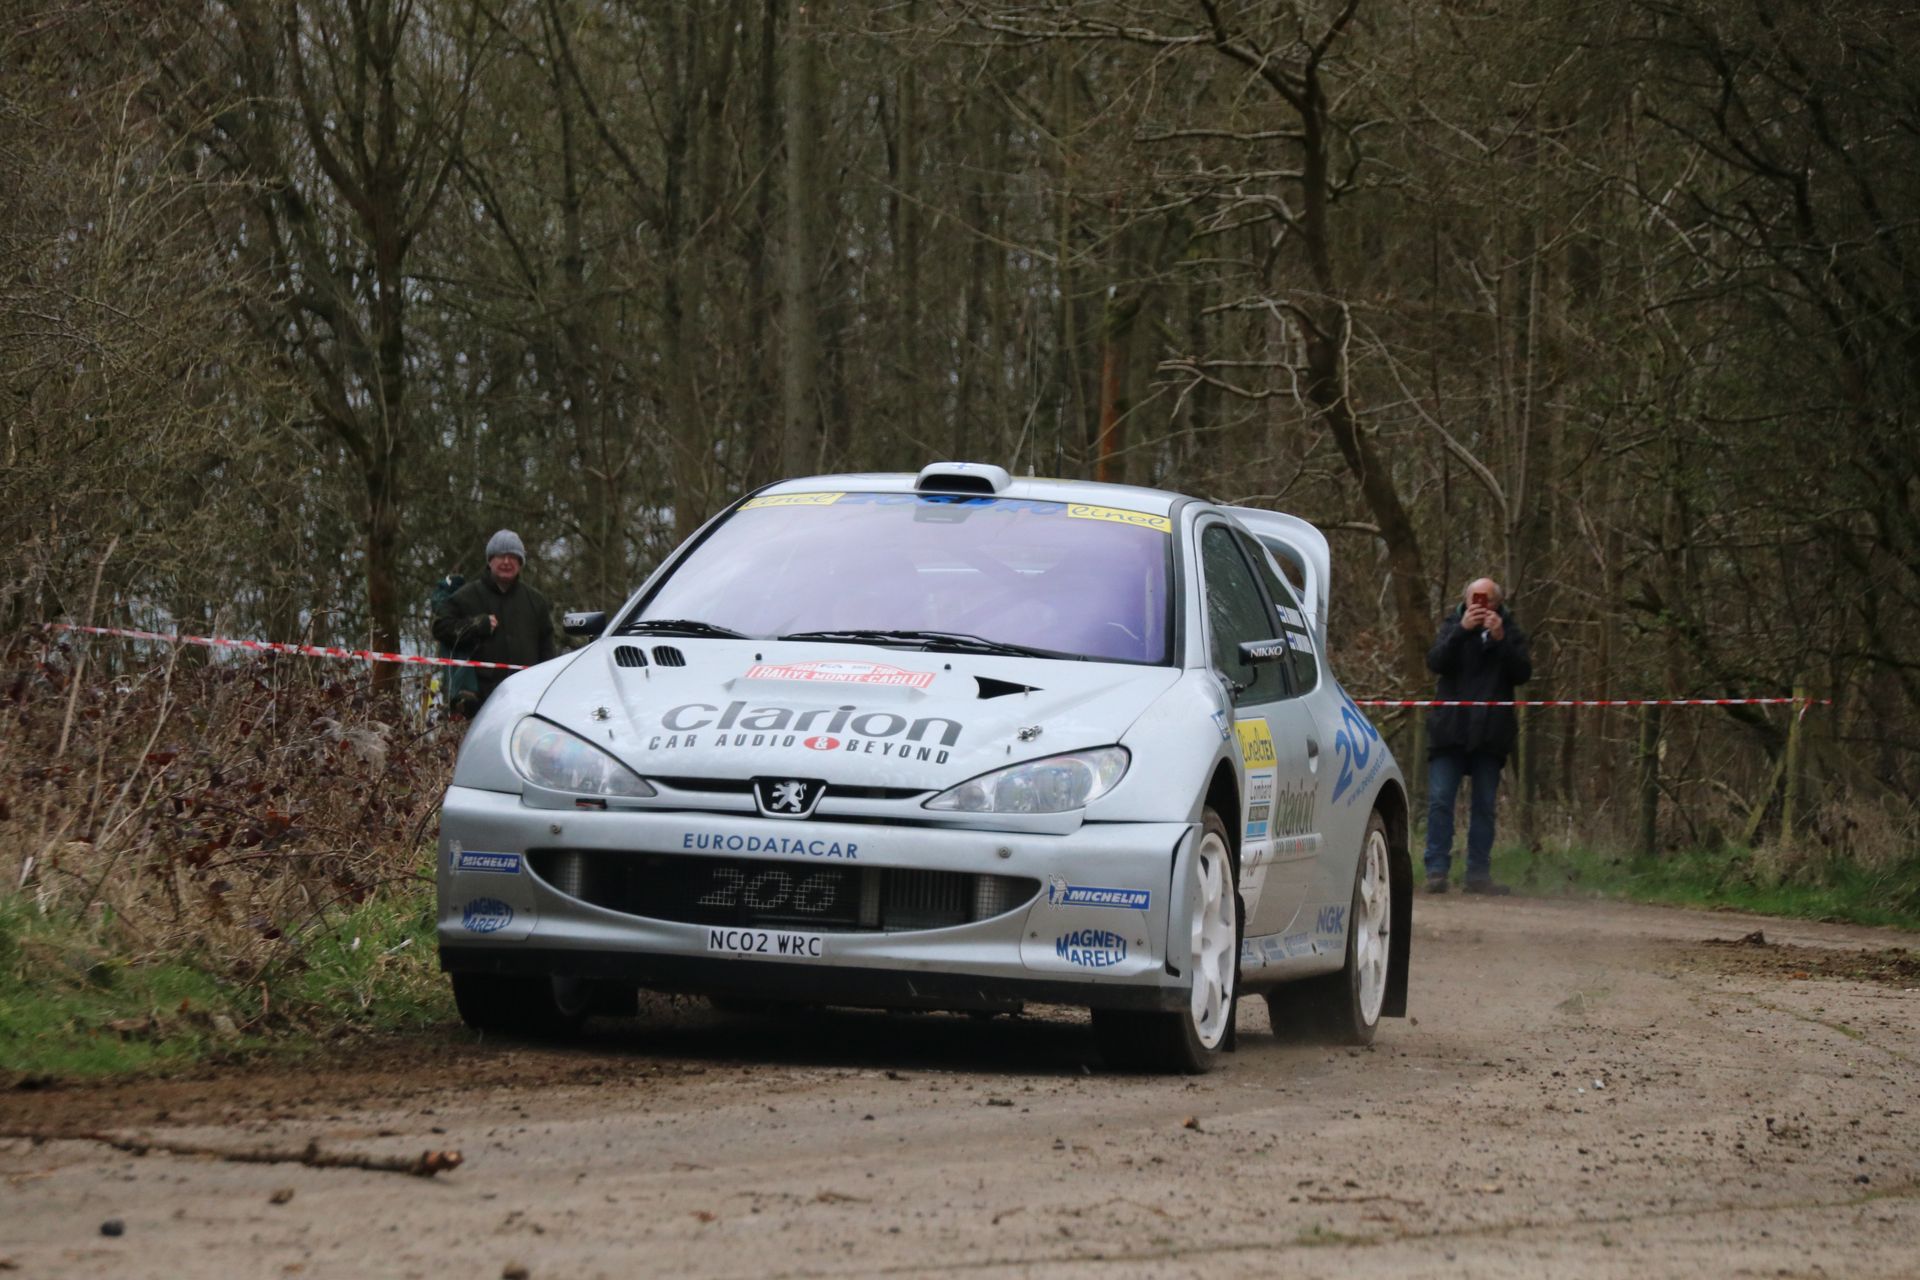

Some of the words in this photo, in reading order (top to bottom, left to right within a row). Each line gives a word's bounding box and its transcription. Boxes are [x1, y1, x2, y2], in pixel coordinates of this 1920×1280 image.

[1250, 645, 1283, 658] NIKKO
[756, 665, 810, 679] RALLYE
[661, 700, 964, 747] clarion
[649, 733, 698, 750] CAR
[715, 733, 796, 748] AUDIO
[846, 738, 950, 764] BEYOND
[1275, 778, 1316, 837] clarion
[683, 832, 858, 859] EURODATACAR
[461, 855, 518, 868] MICHELIN
[696, 868, 842, 912] 206
[1069, 890, 1147, 905] MICHELIN
[1316, 906, 1345, 934] NGK
[710, 930, 768, 953] NC02
[777, 935, 821, 956] WRC
[1056, 929, 1127, 953] MAGNETI
[1056, 943, 1127, 968] MARELLI
